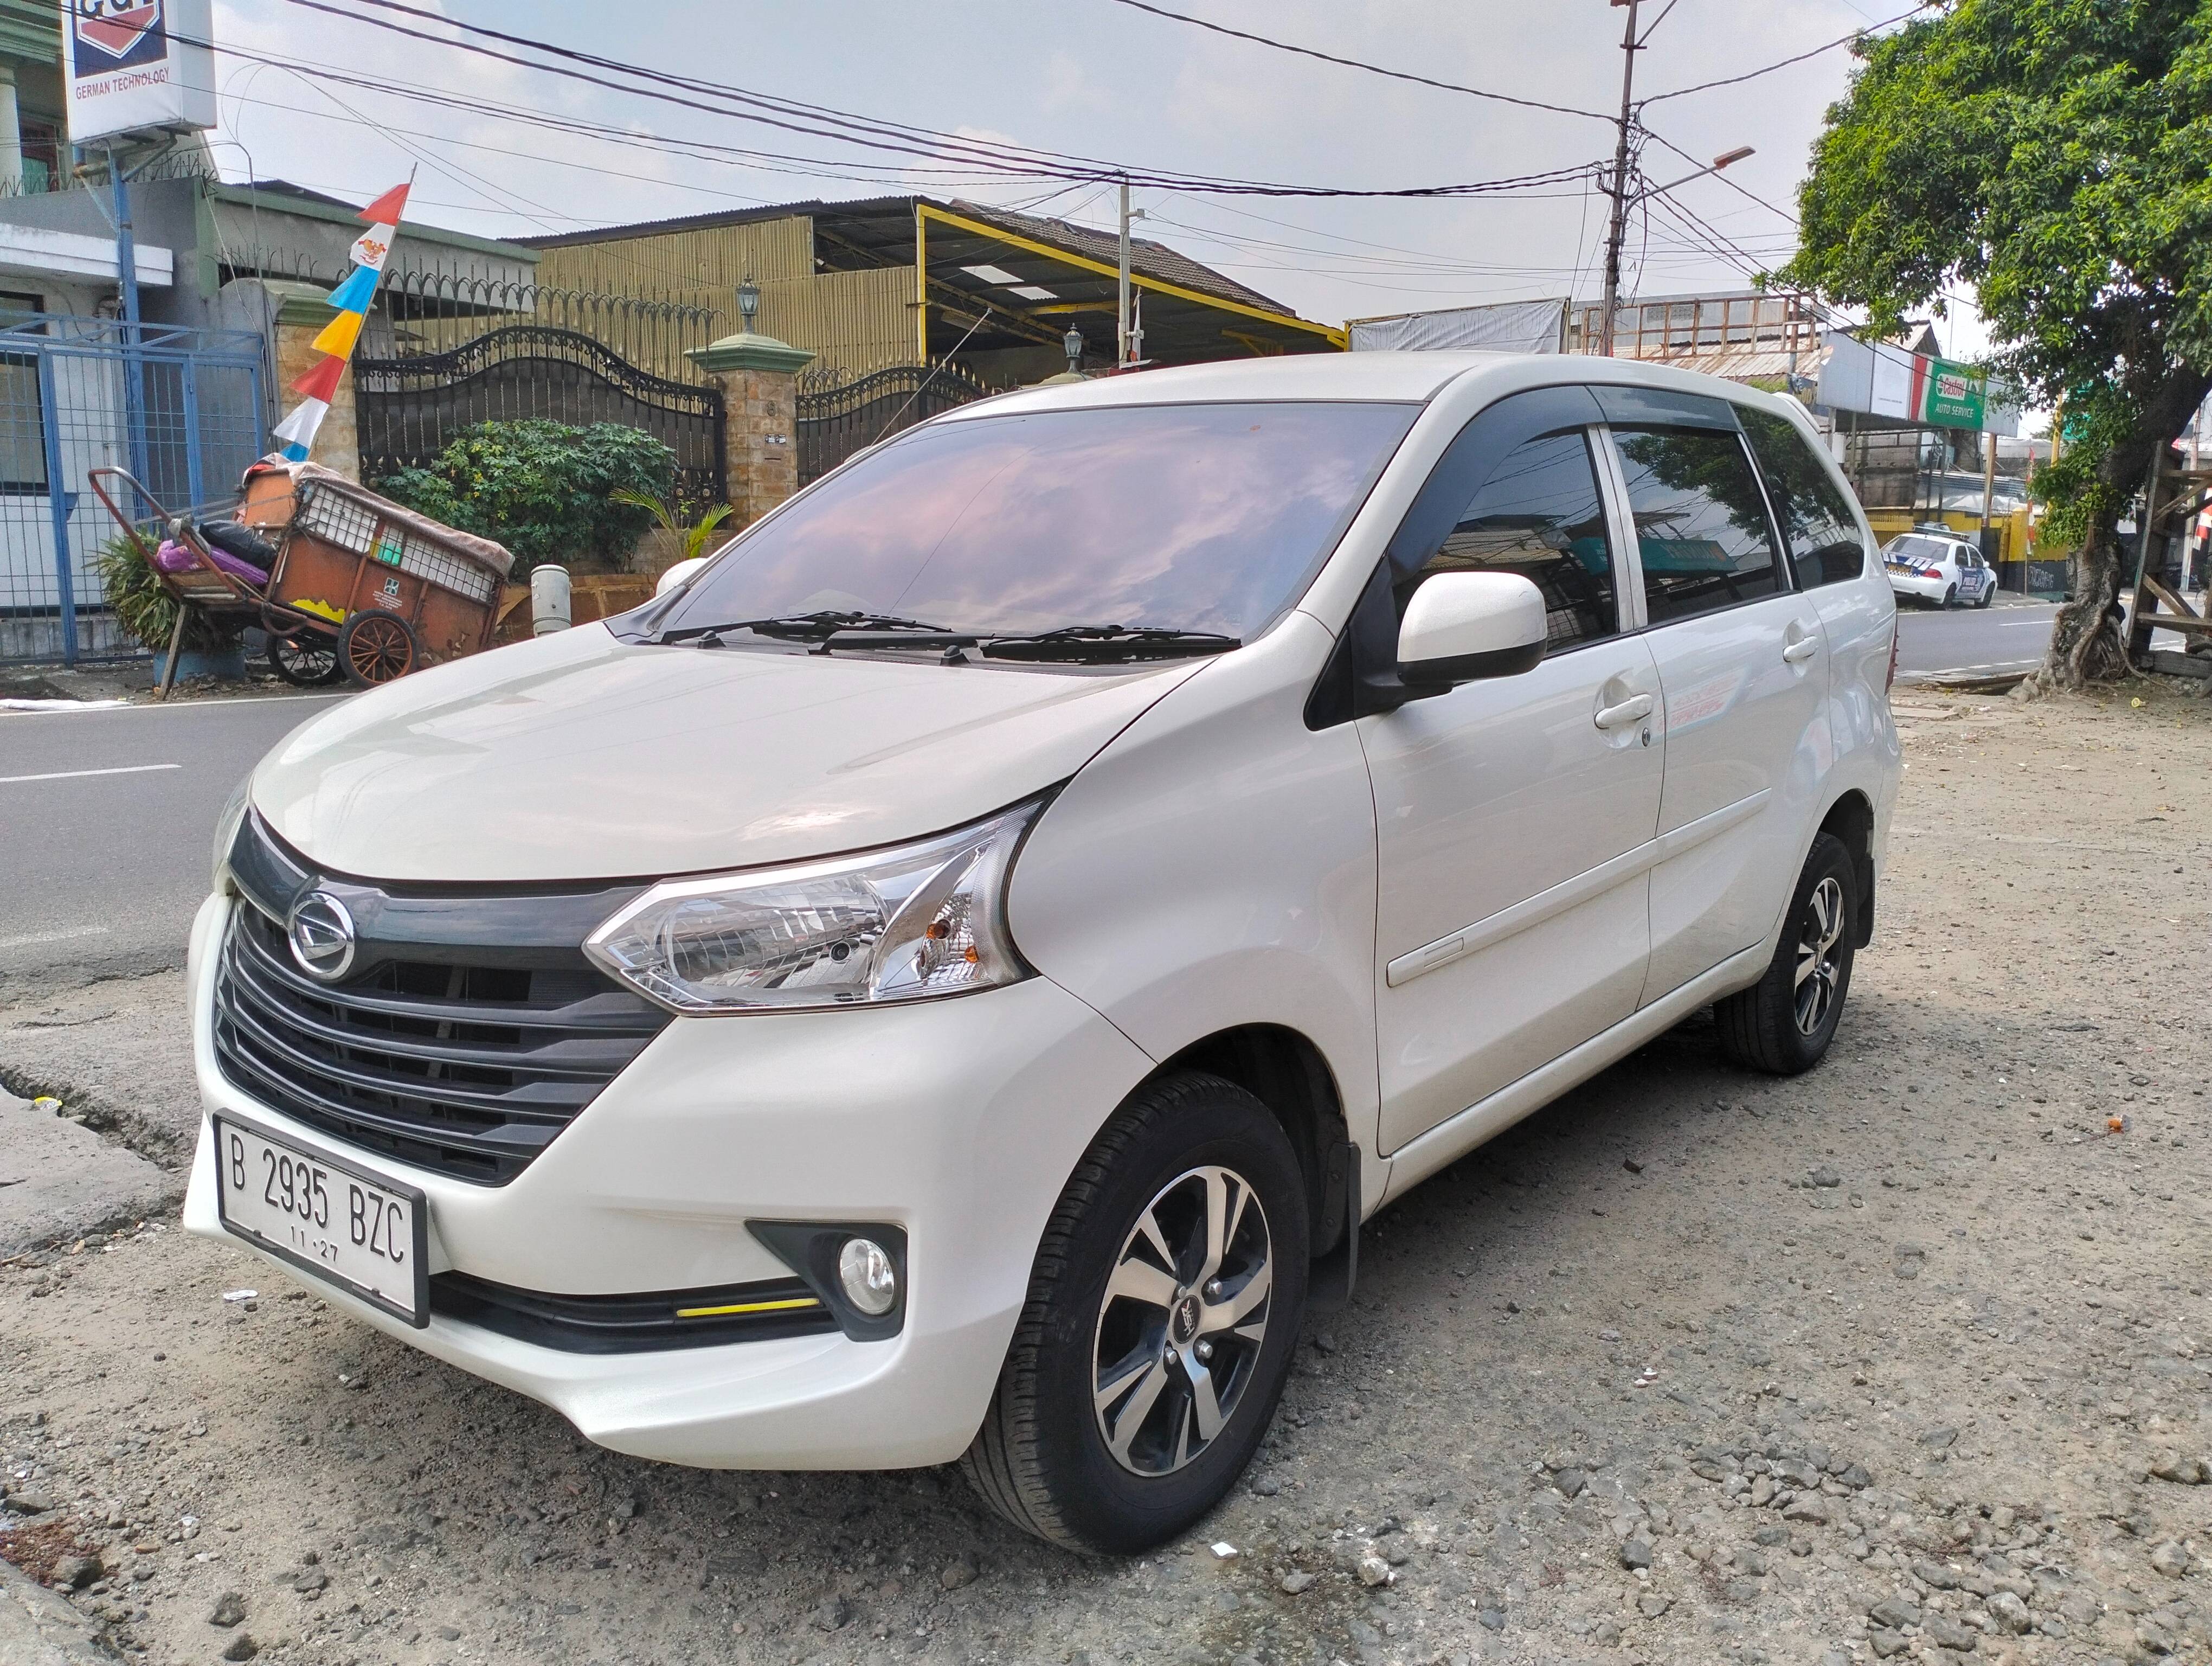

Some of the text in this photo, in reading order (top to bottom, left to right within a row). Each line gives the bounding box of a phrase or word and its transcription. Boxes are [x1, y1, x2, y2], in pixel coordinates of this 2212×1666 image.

[76, 66, 170, 100] GERMAN TECHNOLOGY
[1944, 377, 1964, 398] Castrol
[1935, 403, 1974, 418] AUTO SERVICE
[231, 1132, 404, 1264] B 2935 BZC
